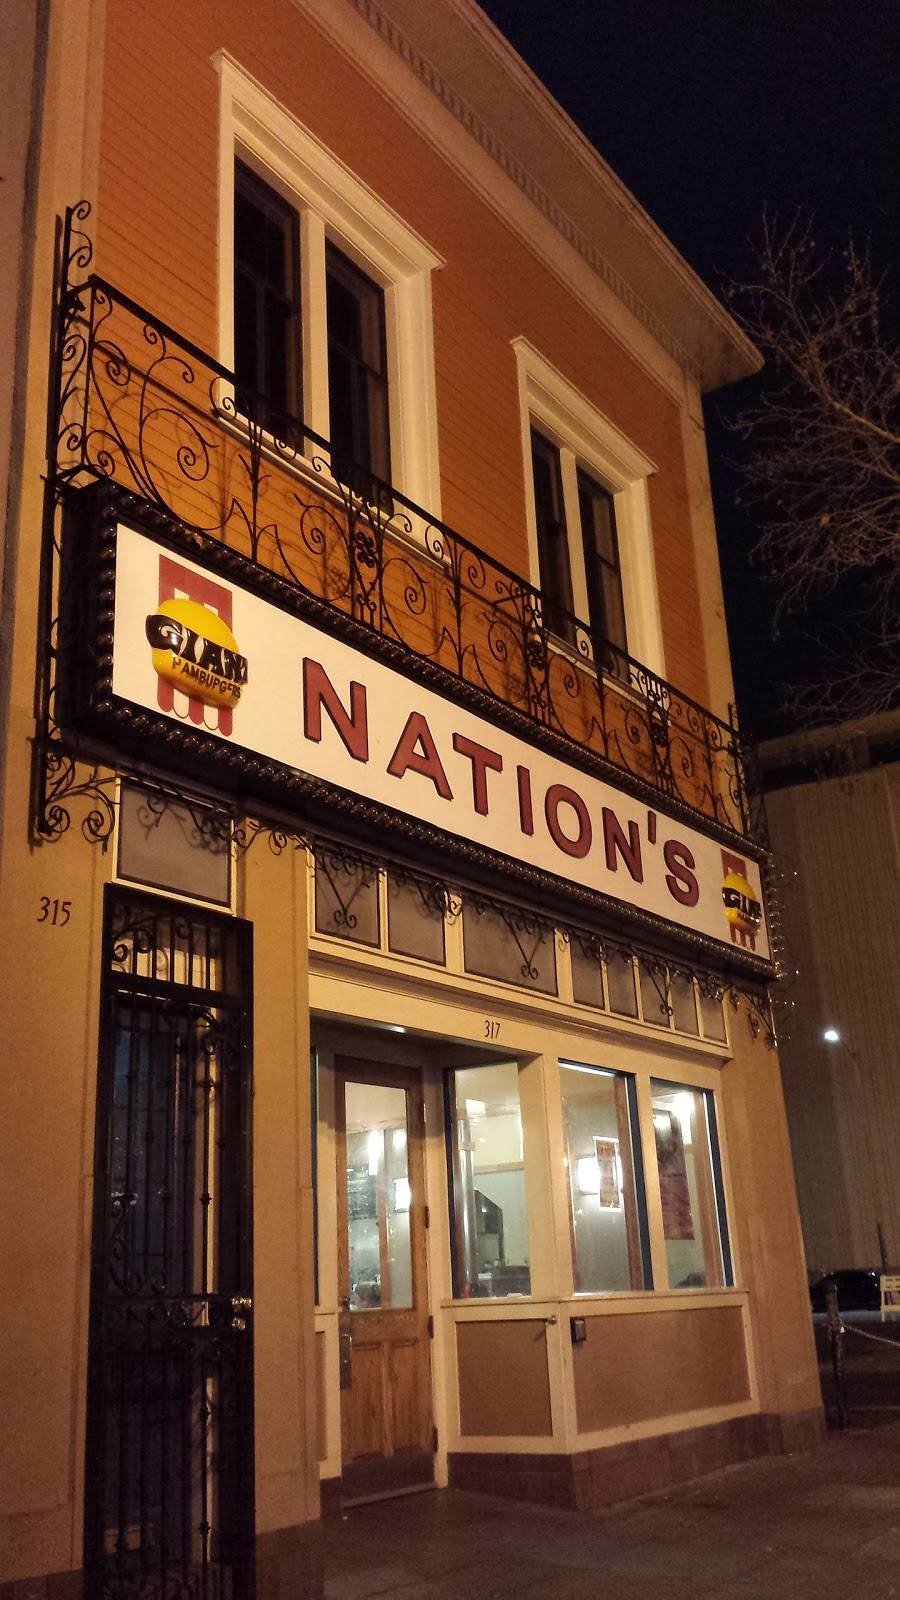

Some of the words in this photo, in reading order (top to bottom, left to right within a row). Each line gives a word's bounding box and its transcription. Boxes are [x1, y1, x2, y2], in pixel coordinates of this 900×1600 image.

[302, 657, 700, 907] NATION'S
[37, 896, 72, 927] 315
[484, 1019, 501, 1039] 317
